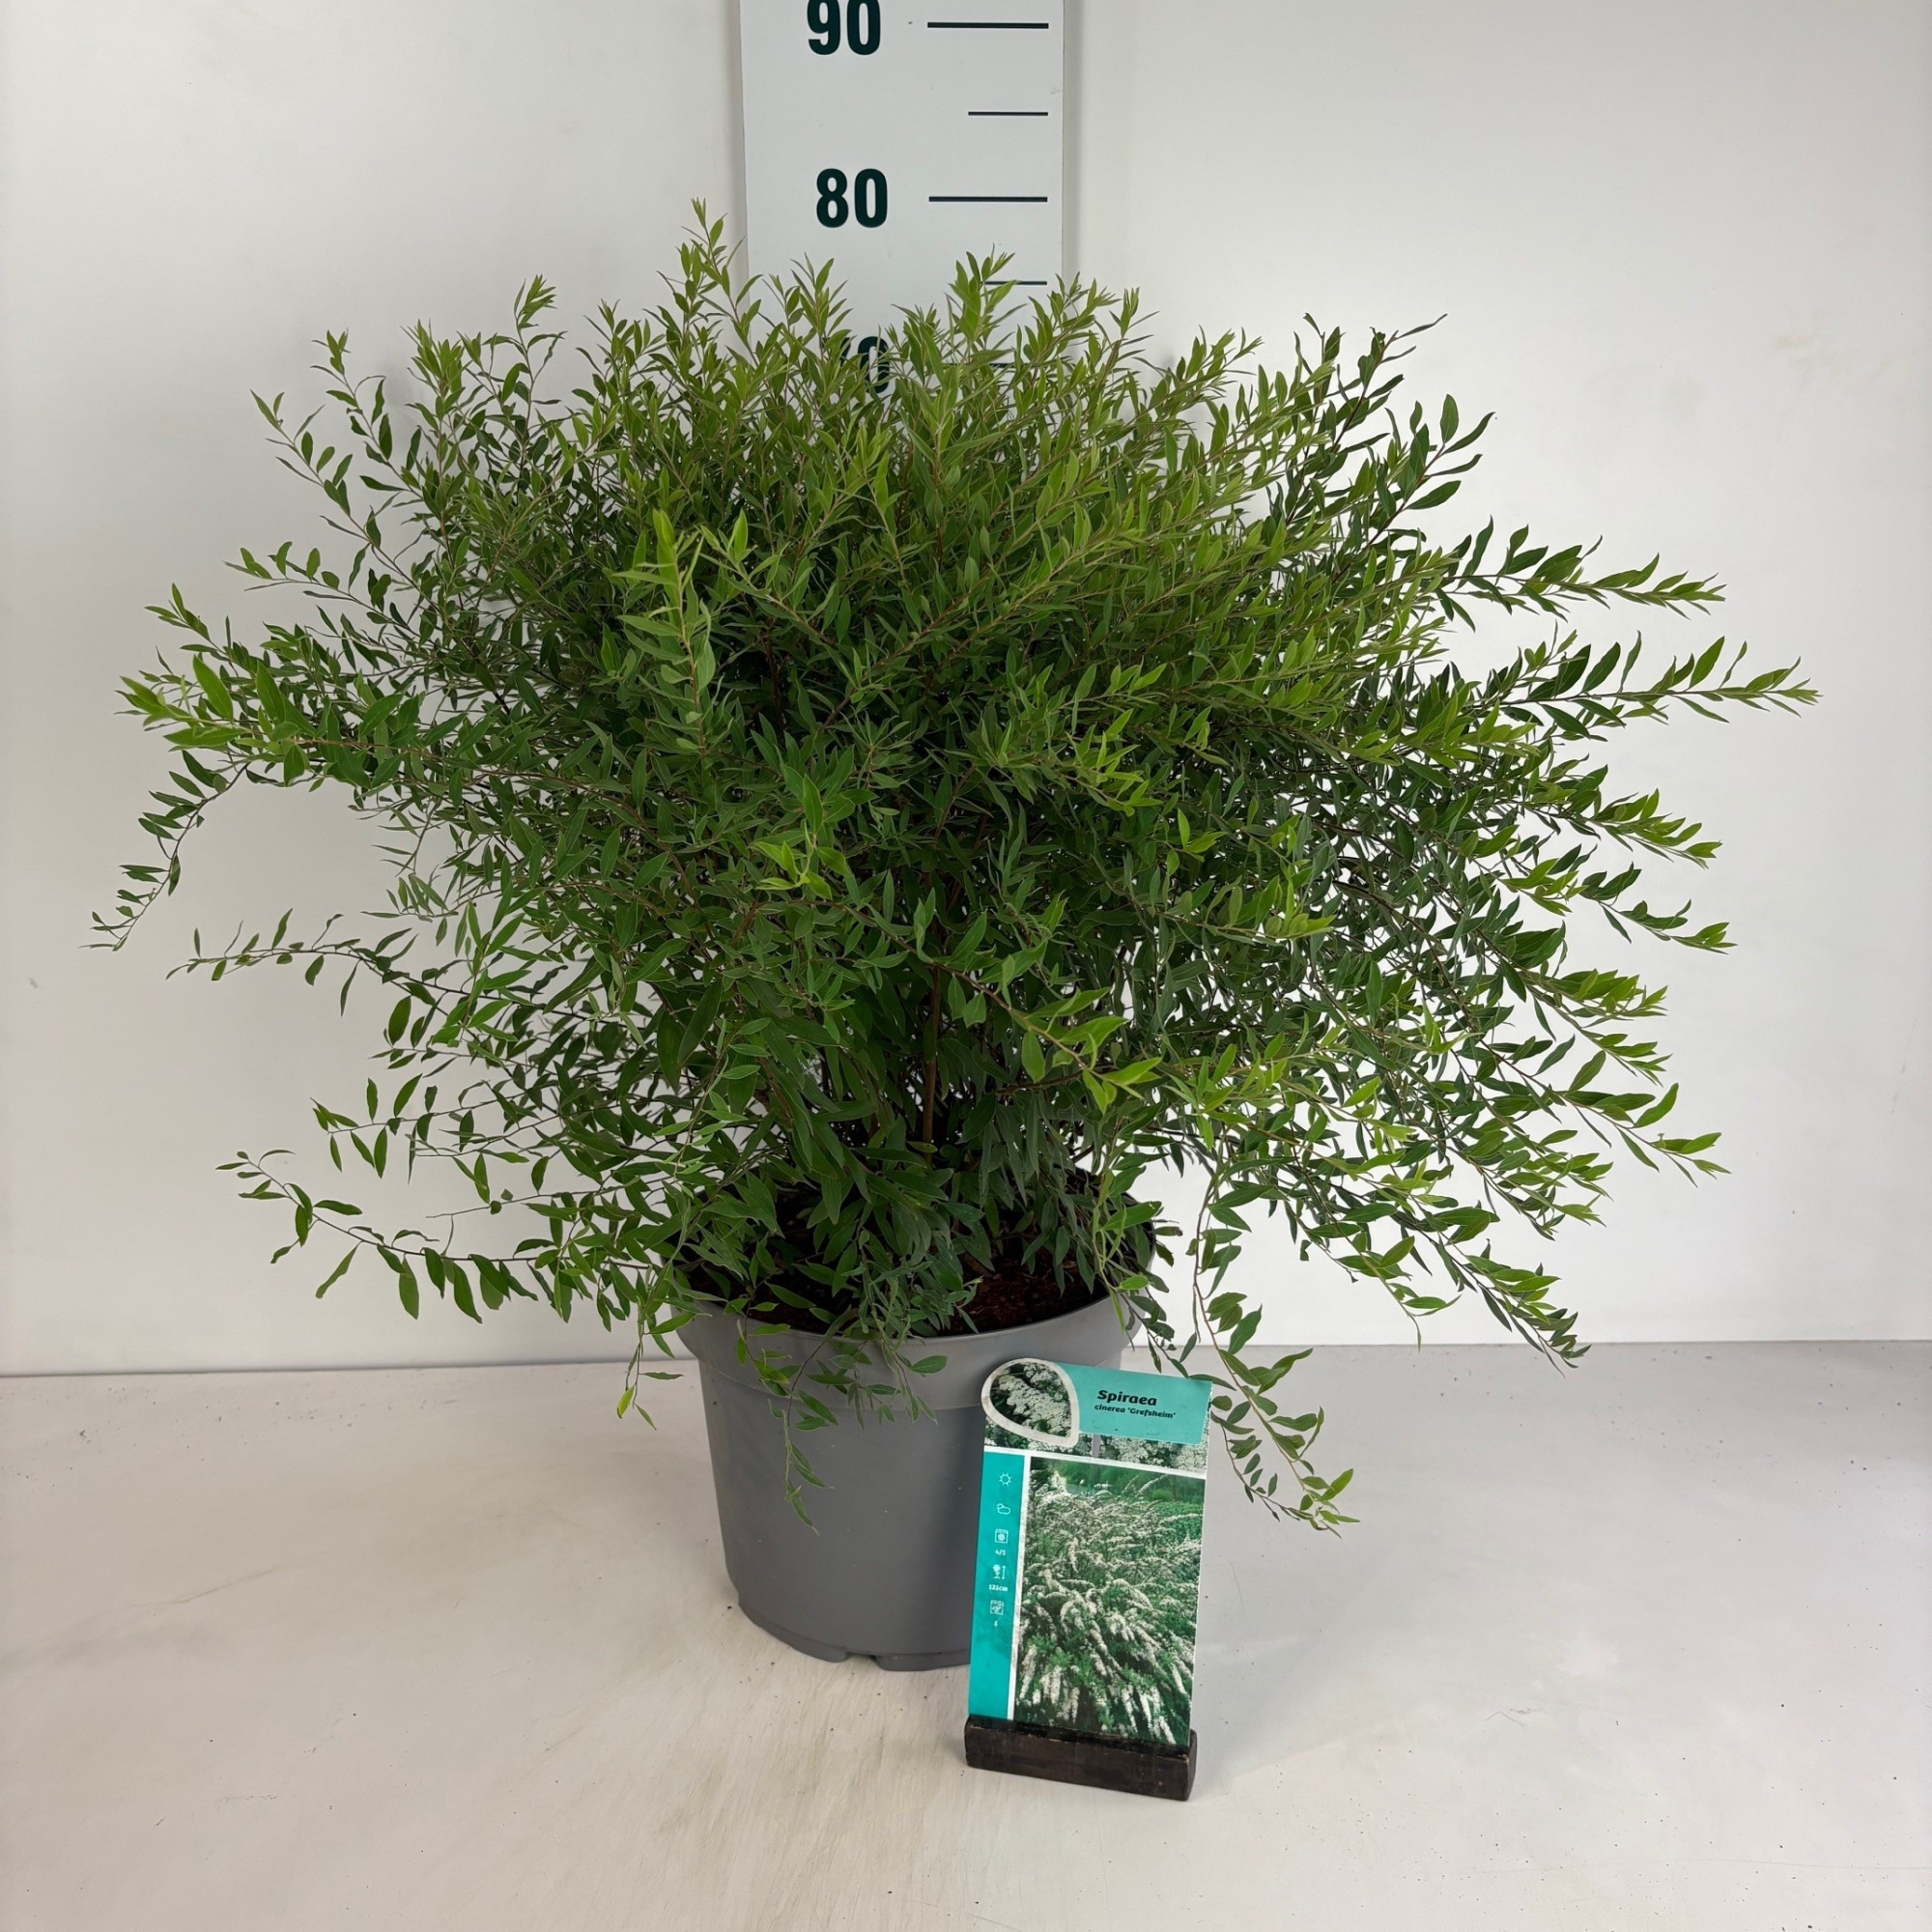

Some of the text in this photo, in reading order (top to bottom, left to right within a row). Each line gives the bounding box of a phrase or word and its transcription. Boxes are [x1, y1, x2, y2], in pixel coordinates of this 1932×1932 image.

[807, 0, 881, 55] 90
[816, 168, 888, 228] 80
[1094, 1404, 1125, 1413] cinerea
[1097, 1389, 1157, 1406] Spiraea
